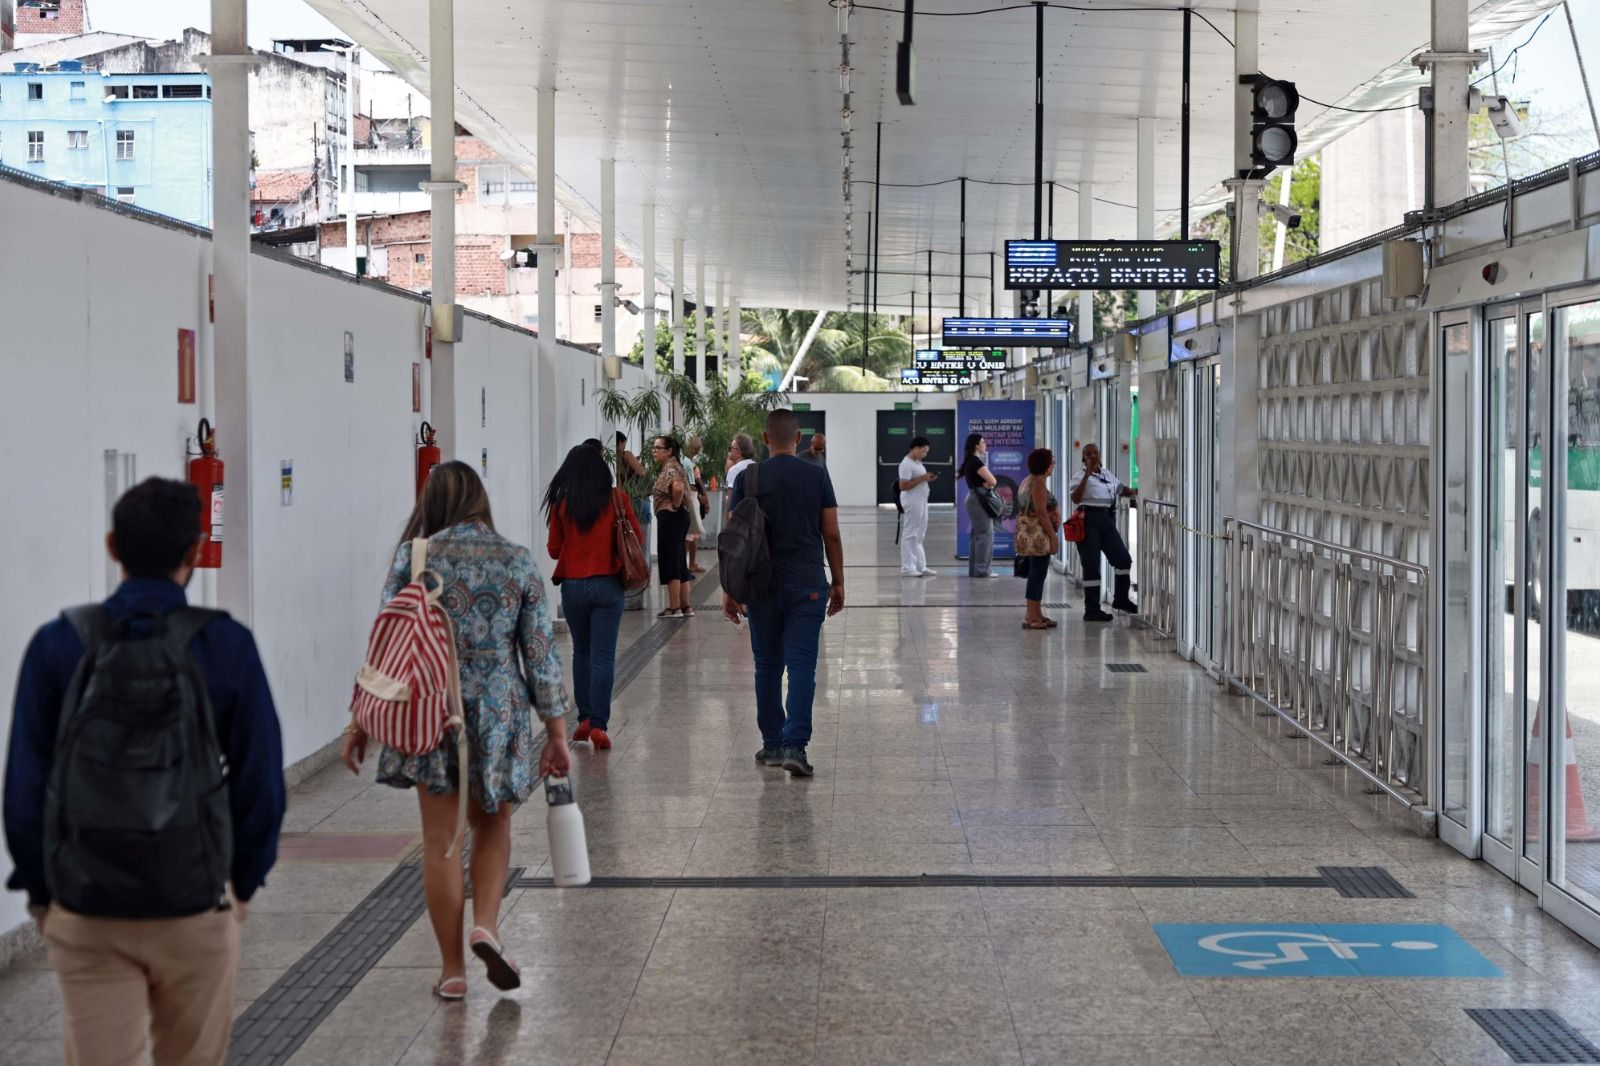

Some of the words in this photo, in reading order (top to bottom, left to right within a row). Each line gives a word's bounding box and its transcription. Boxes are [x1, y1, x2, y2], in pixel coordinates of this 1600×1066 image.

[1009, 268, 1099, 287] ESPAÇO
[1110, 268, 1187, 283] ENTRE
[1197, 268, 1216, 283] O
